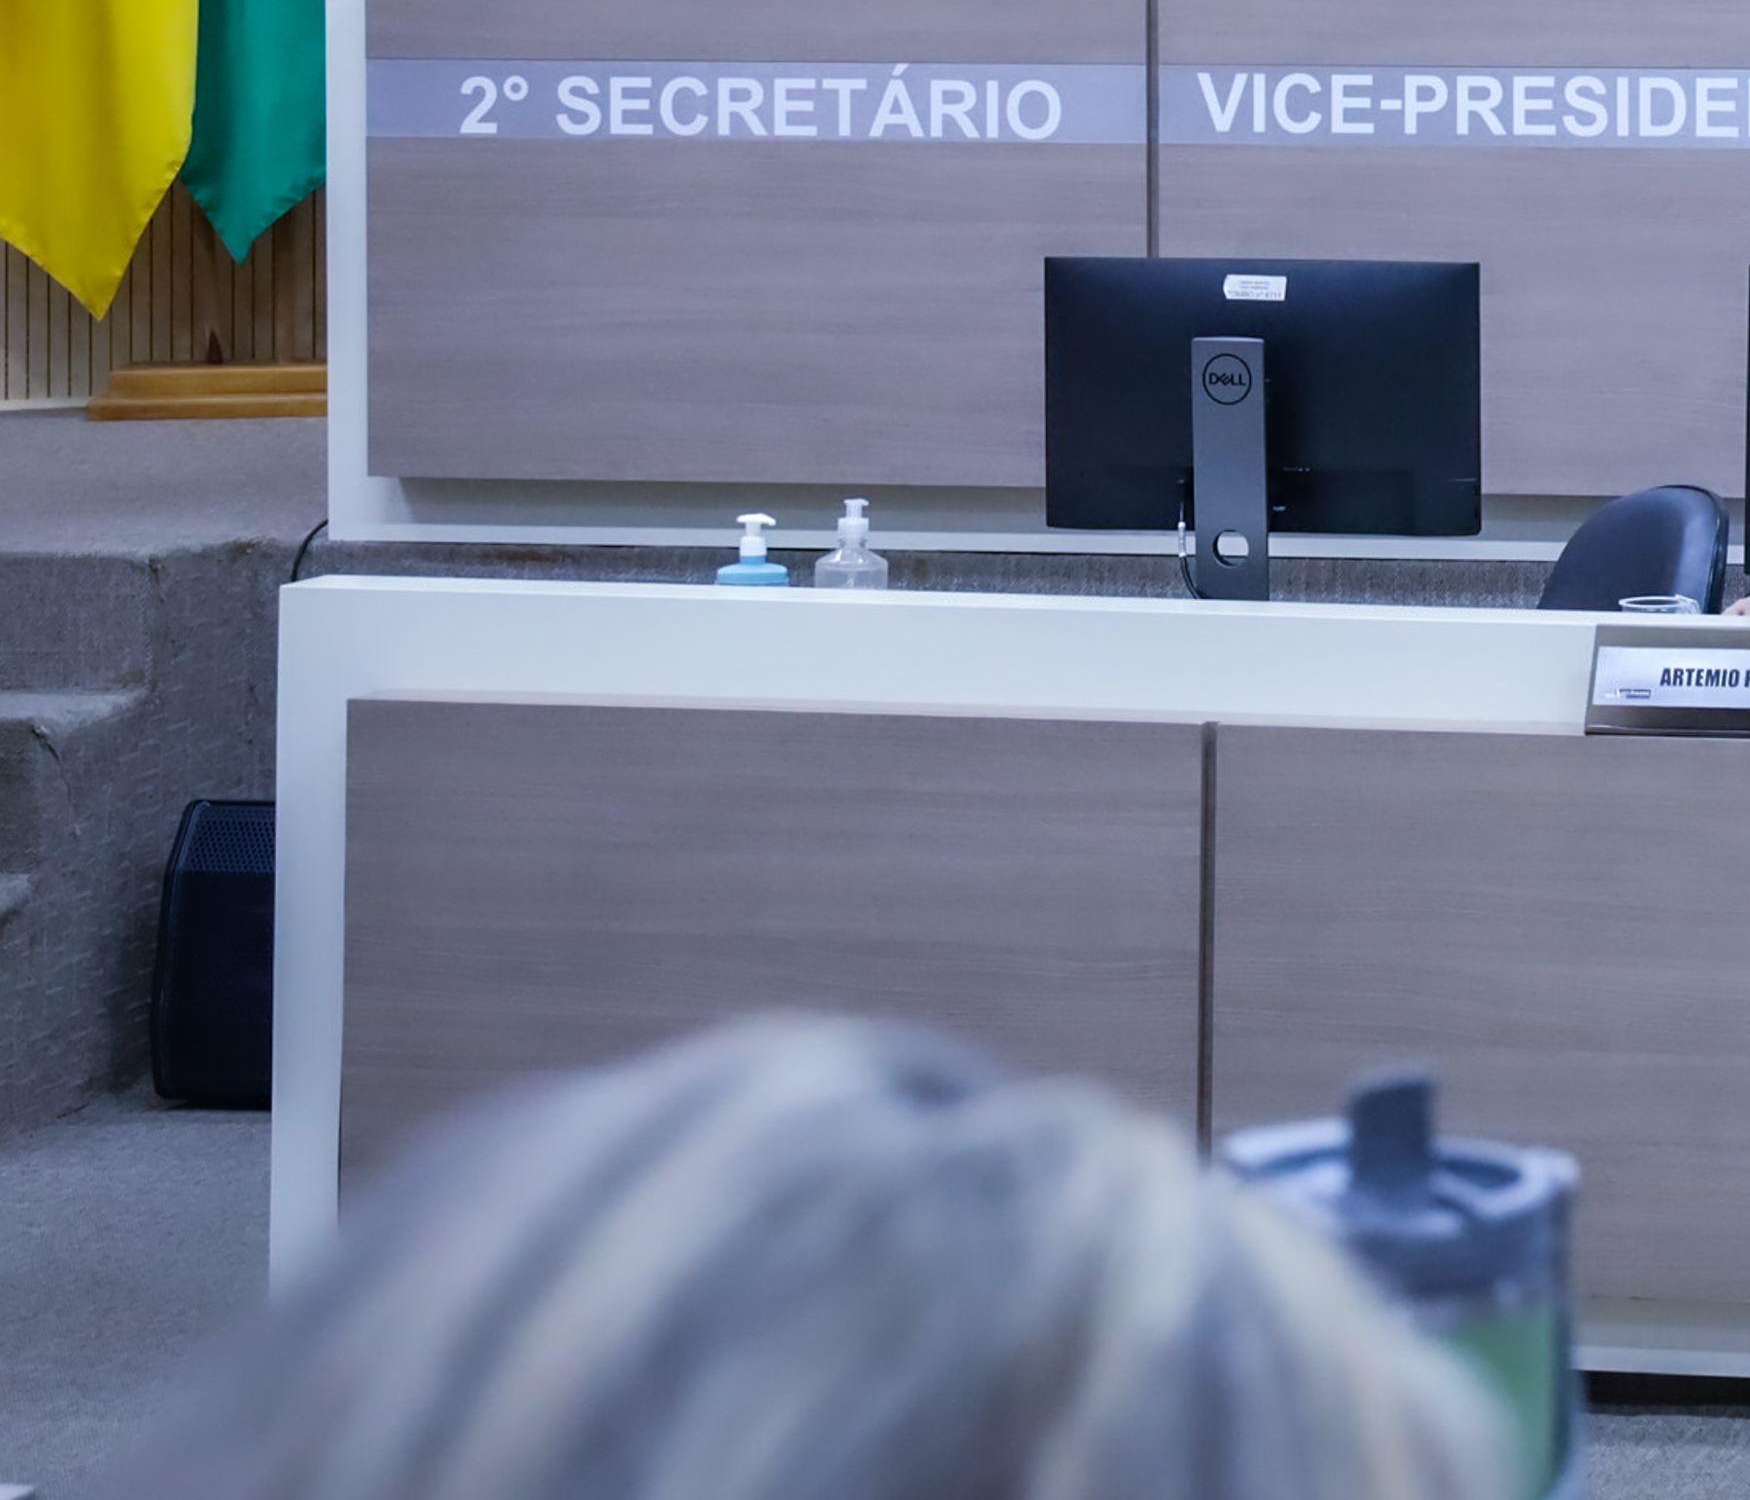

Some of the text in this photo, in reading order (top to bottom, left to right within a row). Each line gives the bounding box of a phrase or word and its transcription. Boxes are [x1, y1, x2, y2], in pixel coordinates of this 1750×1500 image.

[556, 63, 1062, 140] SECRETÁRIO
[1208, 372, 1247, 387] DELL
[1659, 667, 1740, 688] ARTEMIO
